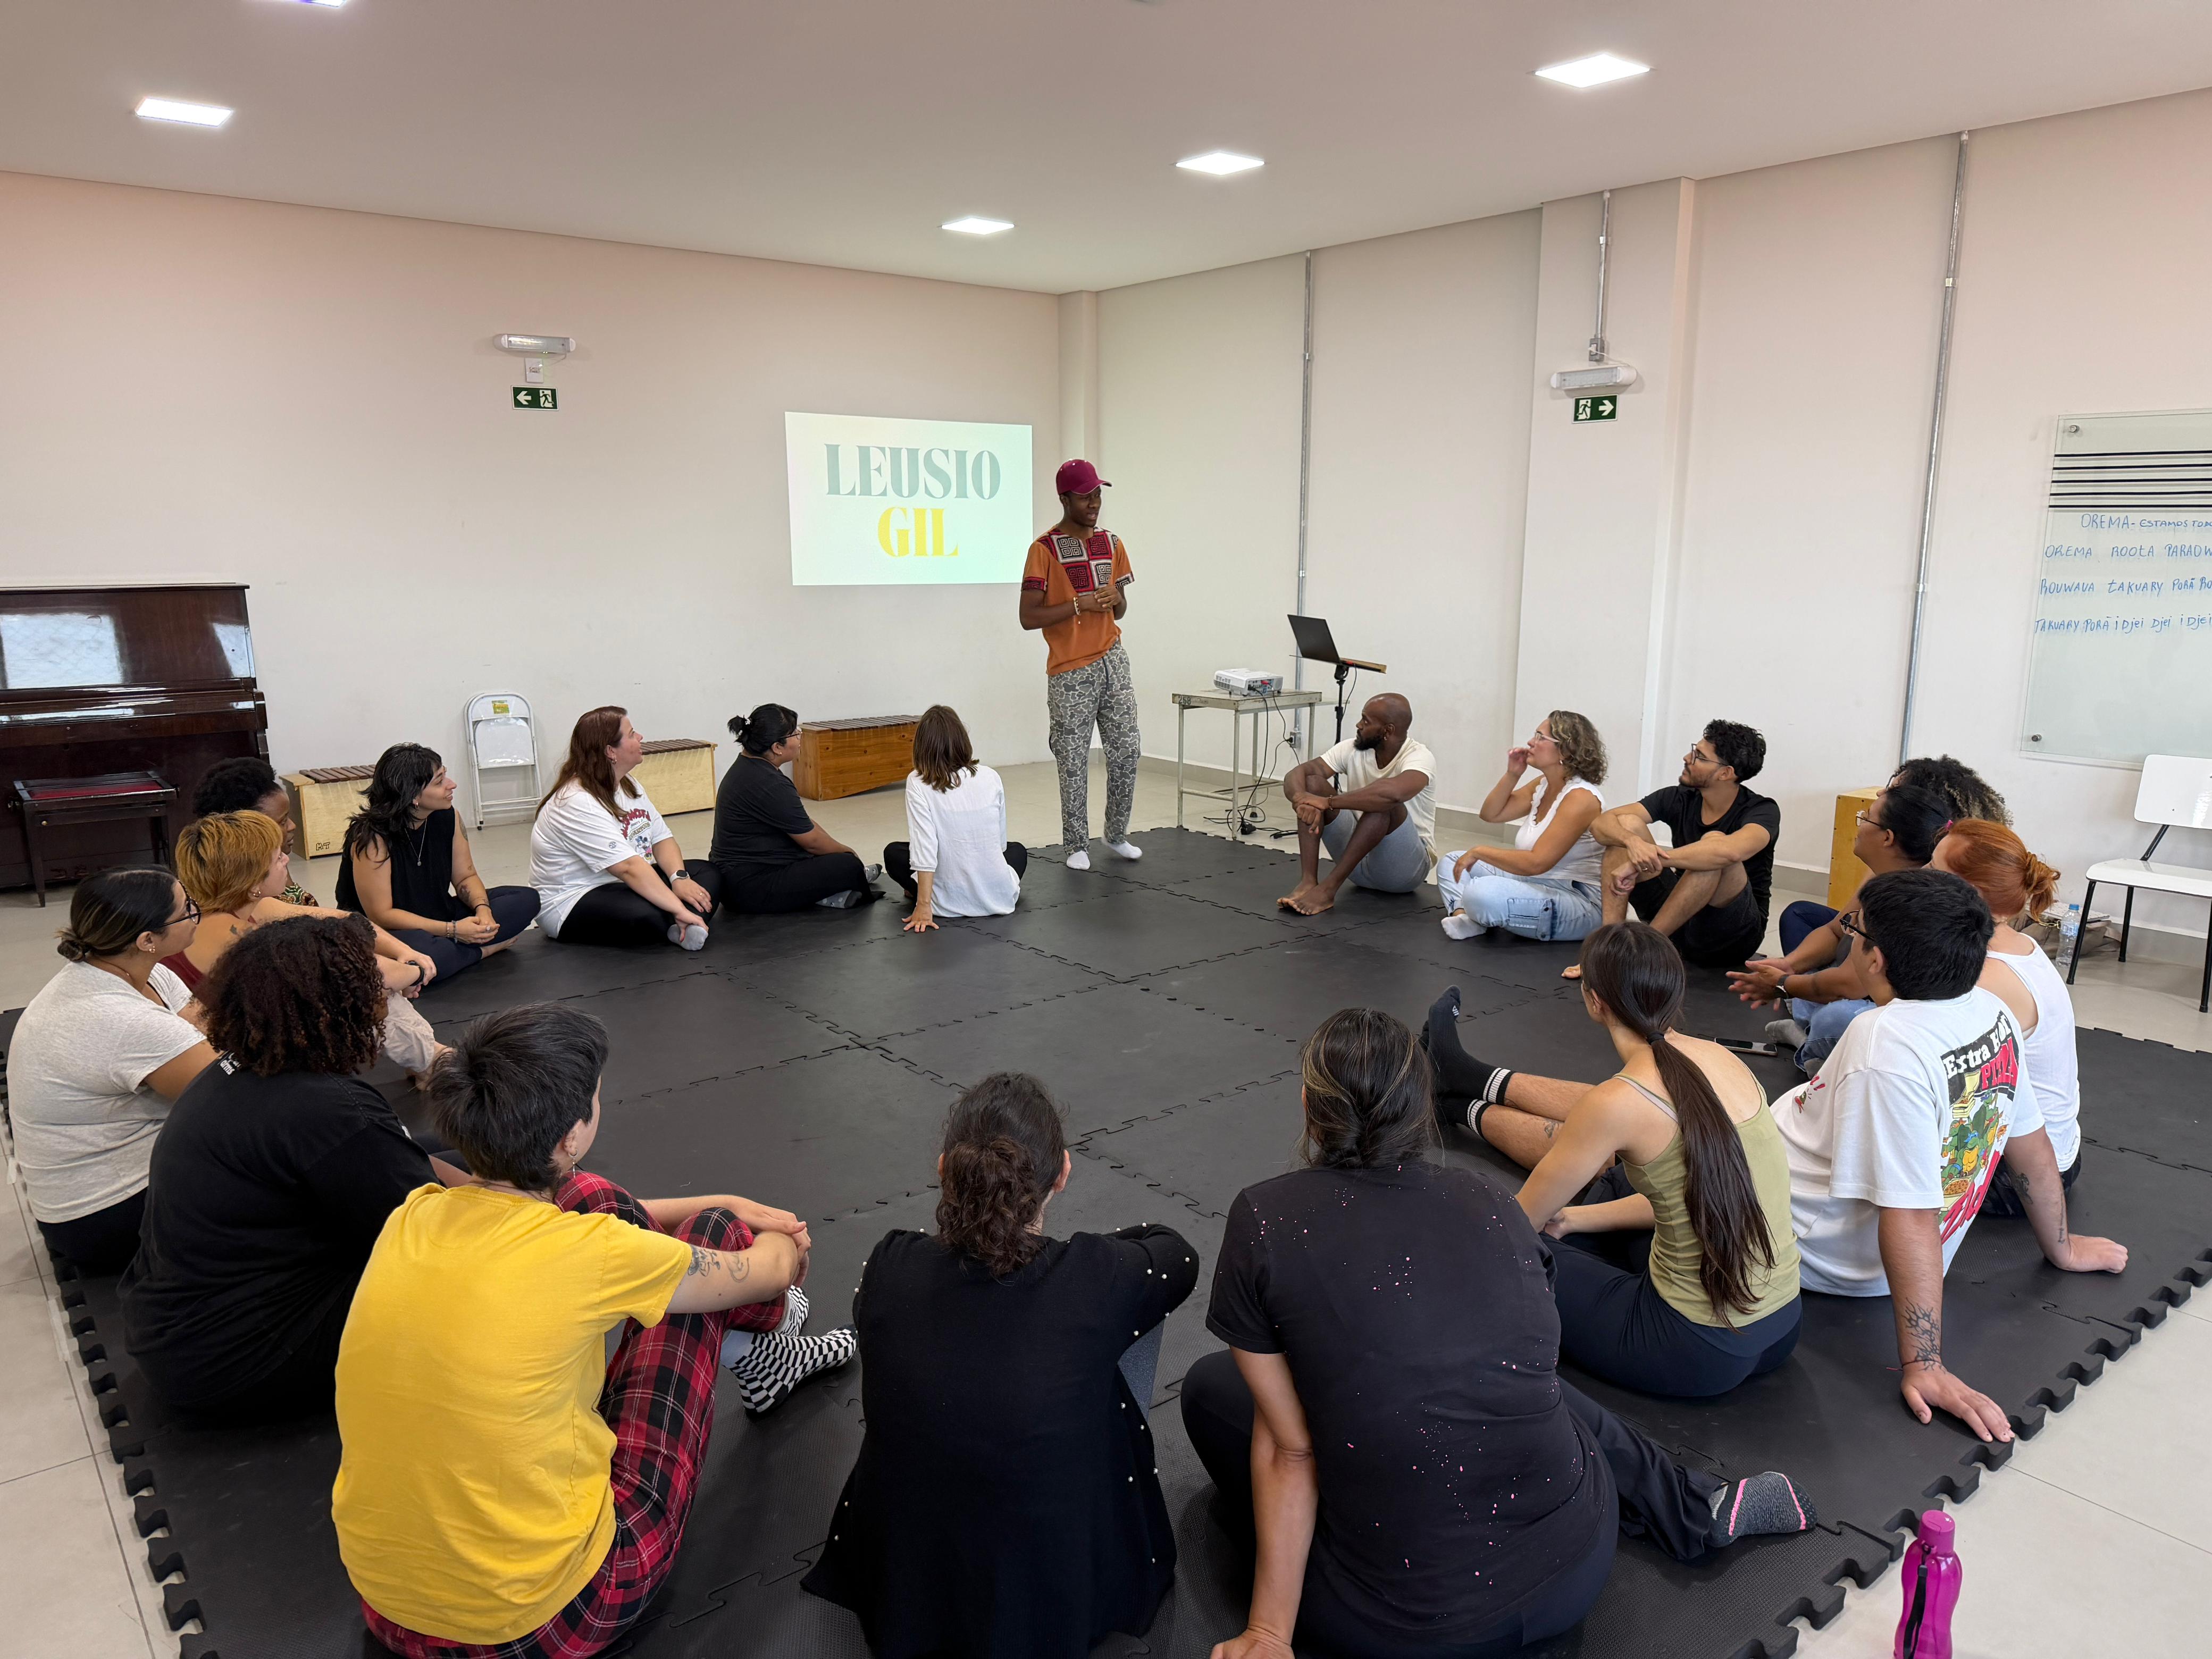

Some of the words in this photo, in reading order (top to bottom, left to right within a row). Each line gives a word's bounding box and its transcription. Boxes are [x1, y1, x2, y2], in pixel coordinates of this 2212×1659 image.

[824, 443, 1001, 500] LEUSIO
[877, 506, 959, 557] GIL
[2140, 519, 2188, 527] ESTAMOS
[2045, 544, 2092, 558] OREMA
[1942, 1044, 1991, 1079] Extra
